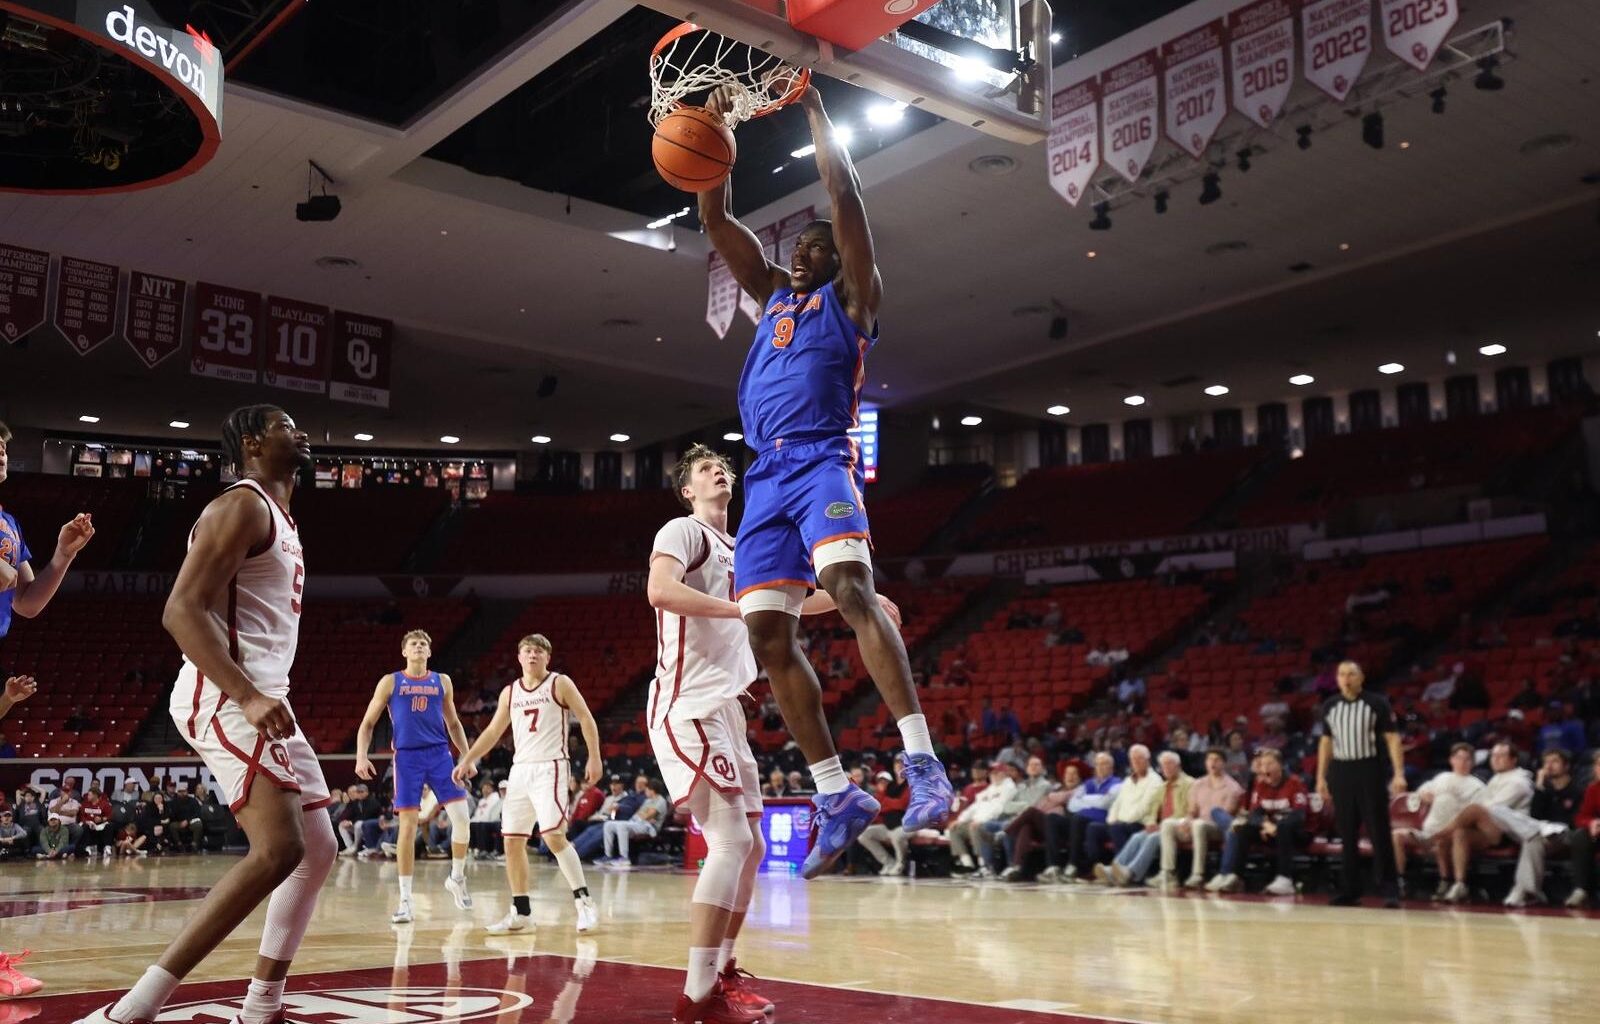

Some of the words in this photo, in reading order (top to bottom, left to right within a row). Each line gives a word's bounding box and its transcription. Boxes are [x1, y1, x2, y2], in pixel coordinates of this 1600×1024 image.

[1389, 0, 1447, 37] 2023
[106, 4, 206, 100] devon
[1313, 25, 1367, 70] 2022
[1242, 58, 1288, 98] 2019
[1176, 88, 1216, 126] 2017
[1112, 116, 1152, 152] 2016
[1052, 140, 1091, 177] 2014
[140, 276, 176, 299] NIT
[214, 294, 245, 311] KING
[200, 308, 254, 356] 33
[271, 306, 325, 326] BLAYLOCK
[345, 320, 382, 339] TUBBS
[772, 317, 795, 348] 9
[275, 322, 318, 367] 10
[346, 338, 378, 380] OU
[82, 573, 138, 592] RAH
[291, 563, 304, 614] 5
[412, 696, 428, 712] 10
[513, 697, 550, 708] OKLAHOMA
[524, 708, 539, 732] 7
[712, 755, 736, 781] OU
